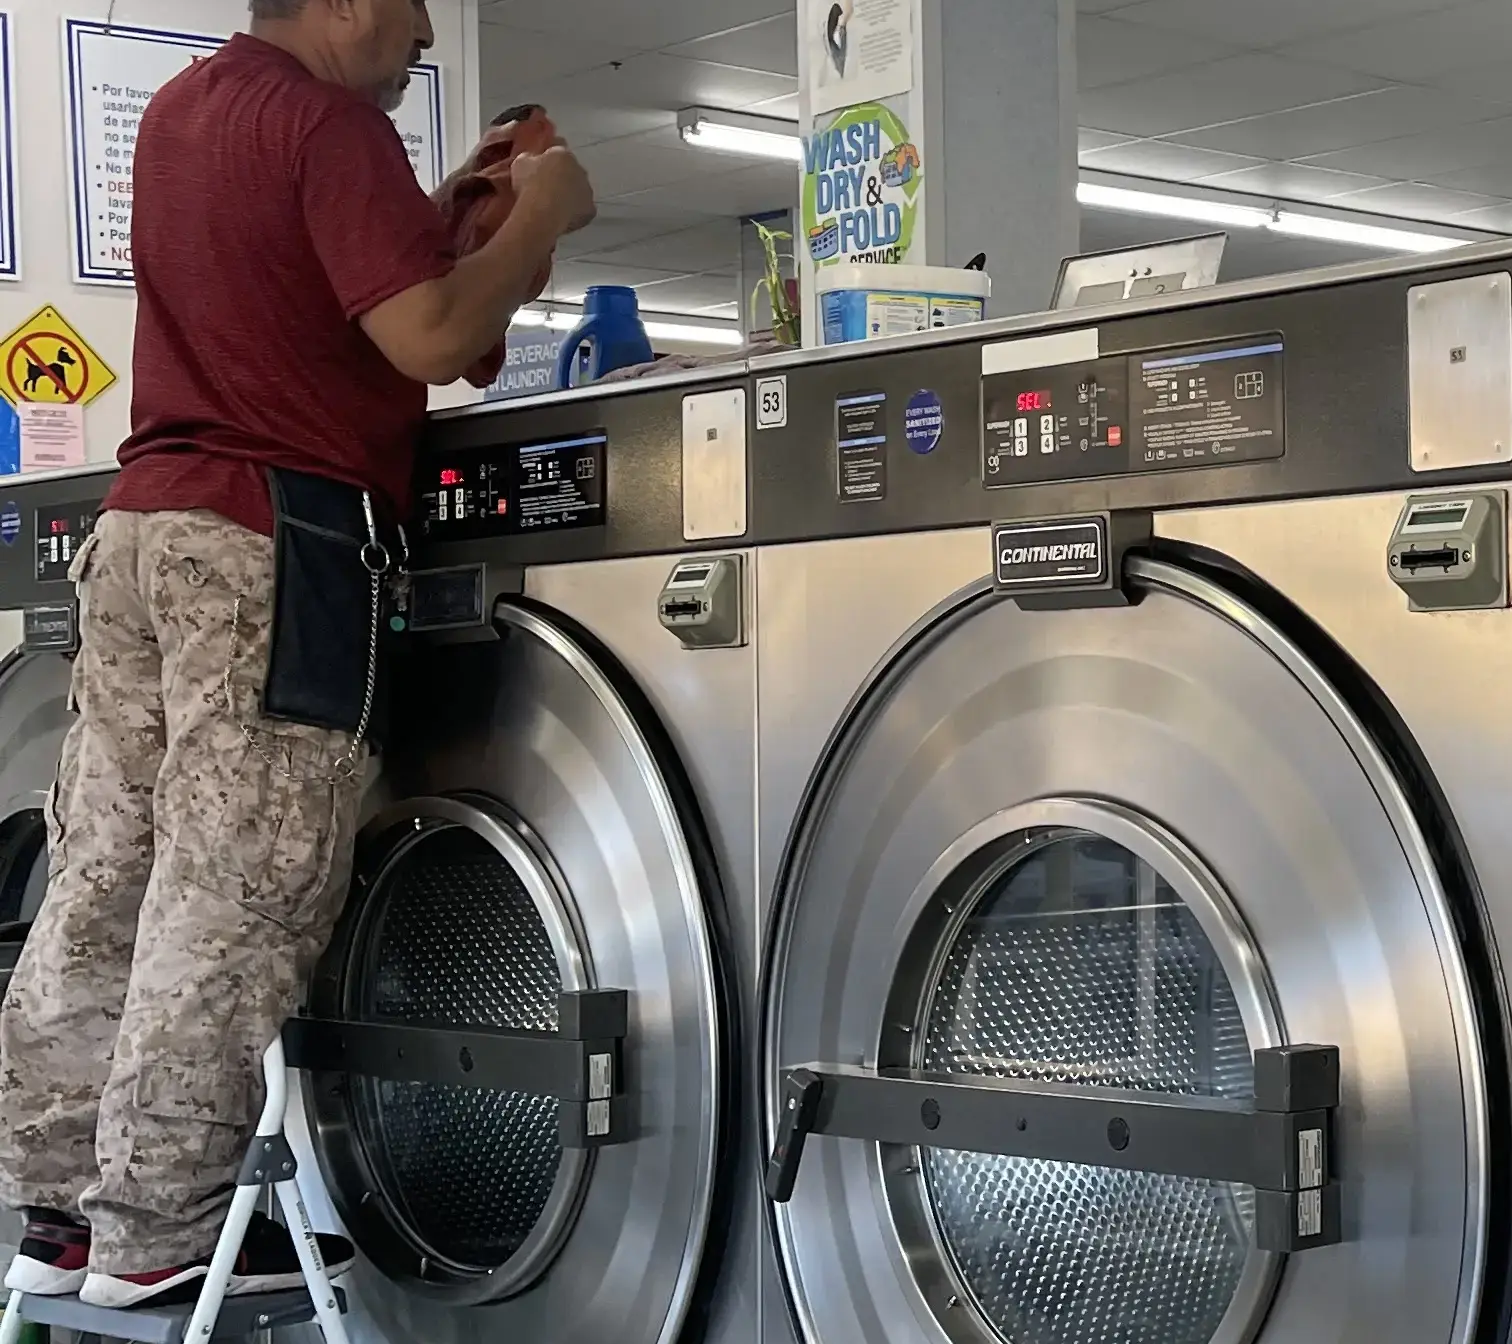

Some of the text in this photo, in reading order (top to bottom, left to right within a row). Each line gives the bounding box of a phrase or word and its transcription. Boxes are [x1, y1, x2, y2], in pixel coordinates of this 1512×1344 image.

[102, 83, 122, 96] Por
[104, 115, 118, 127] de
[104, 132, 119, 142] no
[105, 146, 119, 158] de
[802, 119, 880, 174] WASH
[105, 162, 121, 174] No
[816, 165, 884, 214] DRY &
[108, 212, 129, 224] Por
[840, 203, 902, 253] FOLD
[506, 341, 560, 366] BEVERAG
[500, 367, 552, 391] LAUNDRY
[763, 391, 780, 413] 53
[1044, 418, 1050, 431] 2
[1018, 437, 1050, 452] 3 4
[1000, 542, 1097, 565] CONTINENTAL
